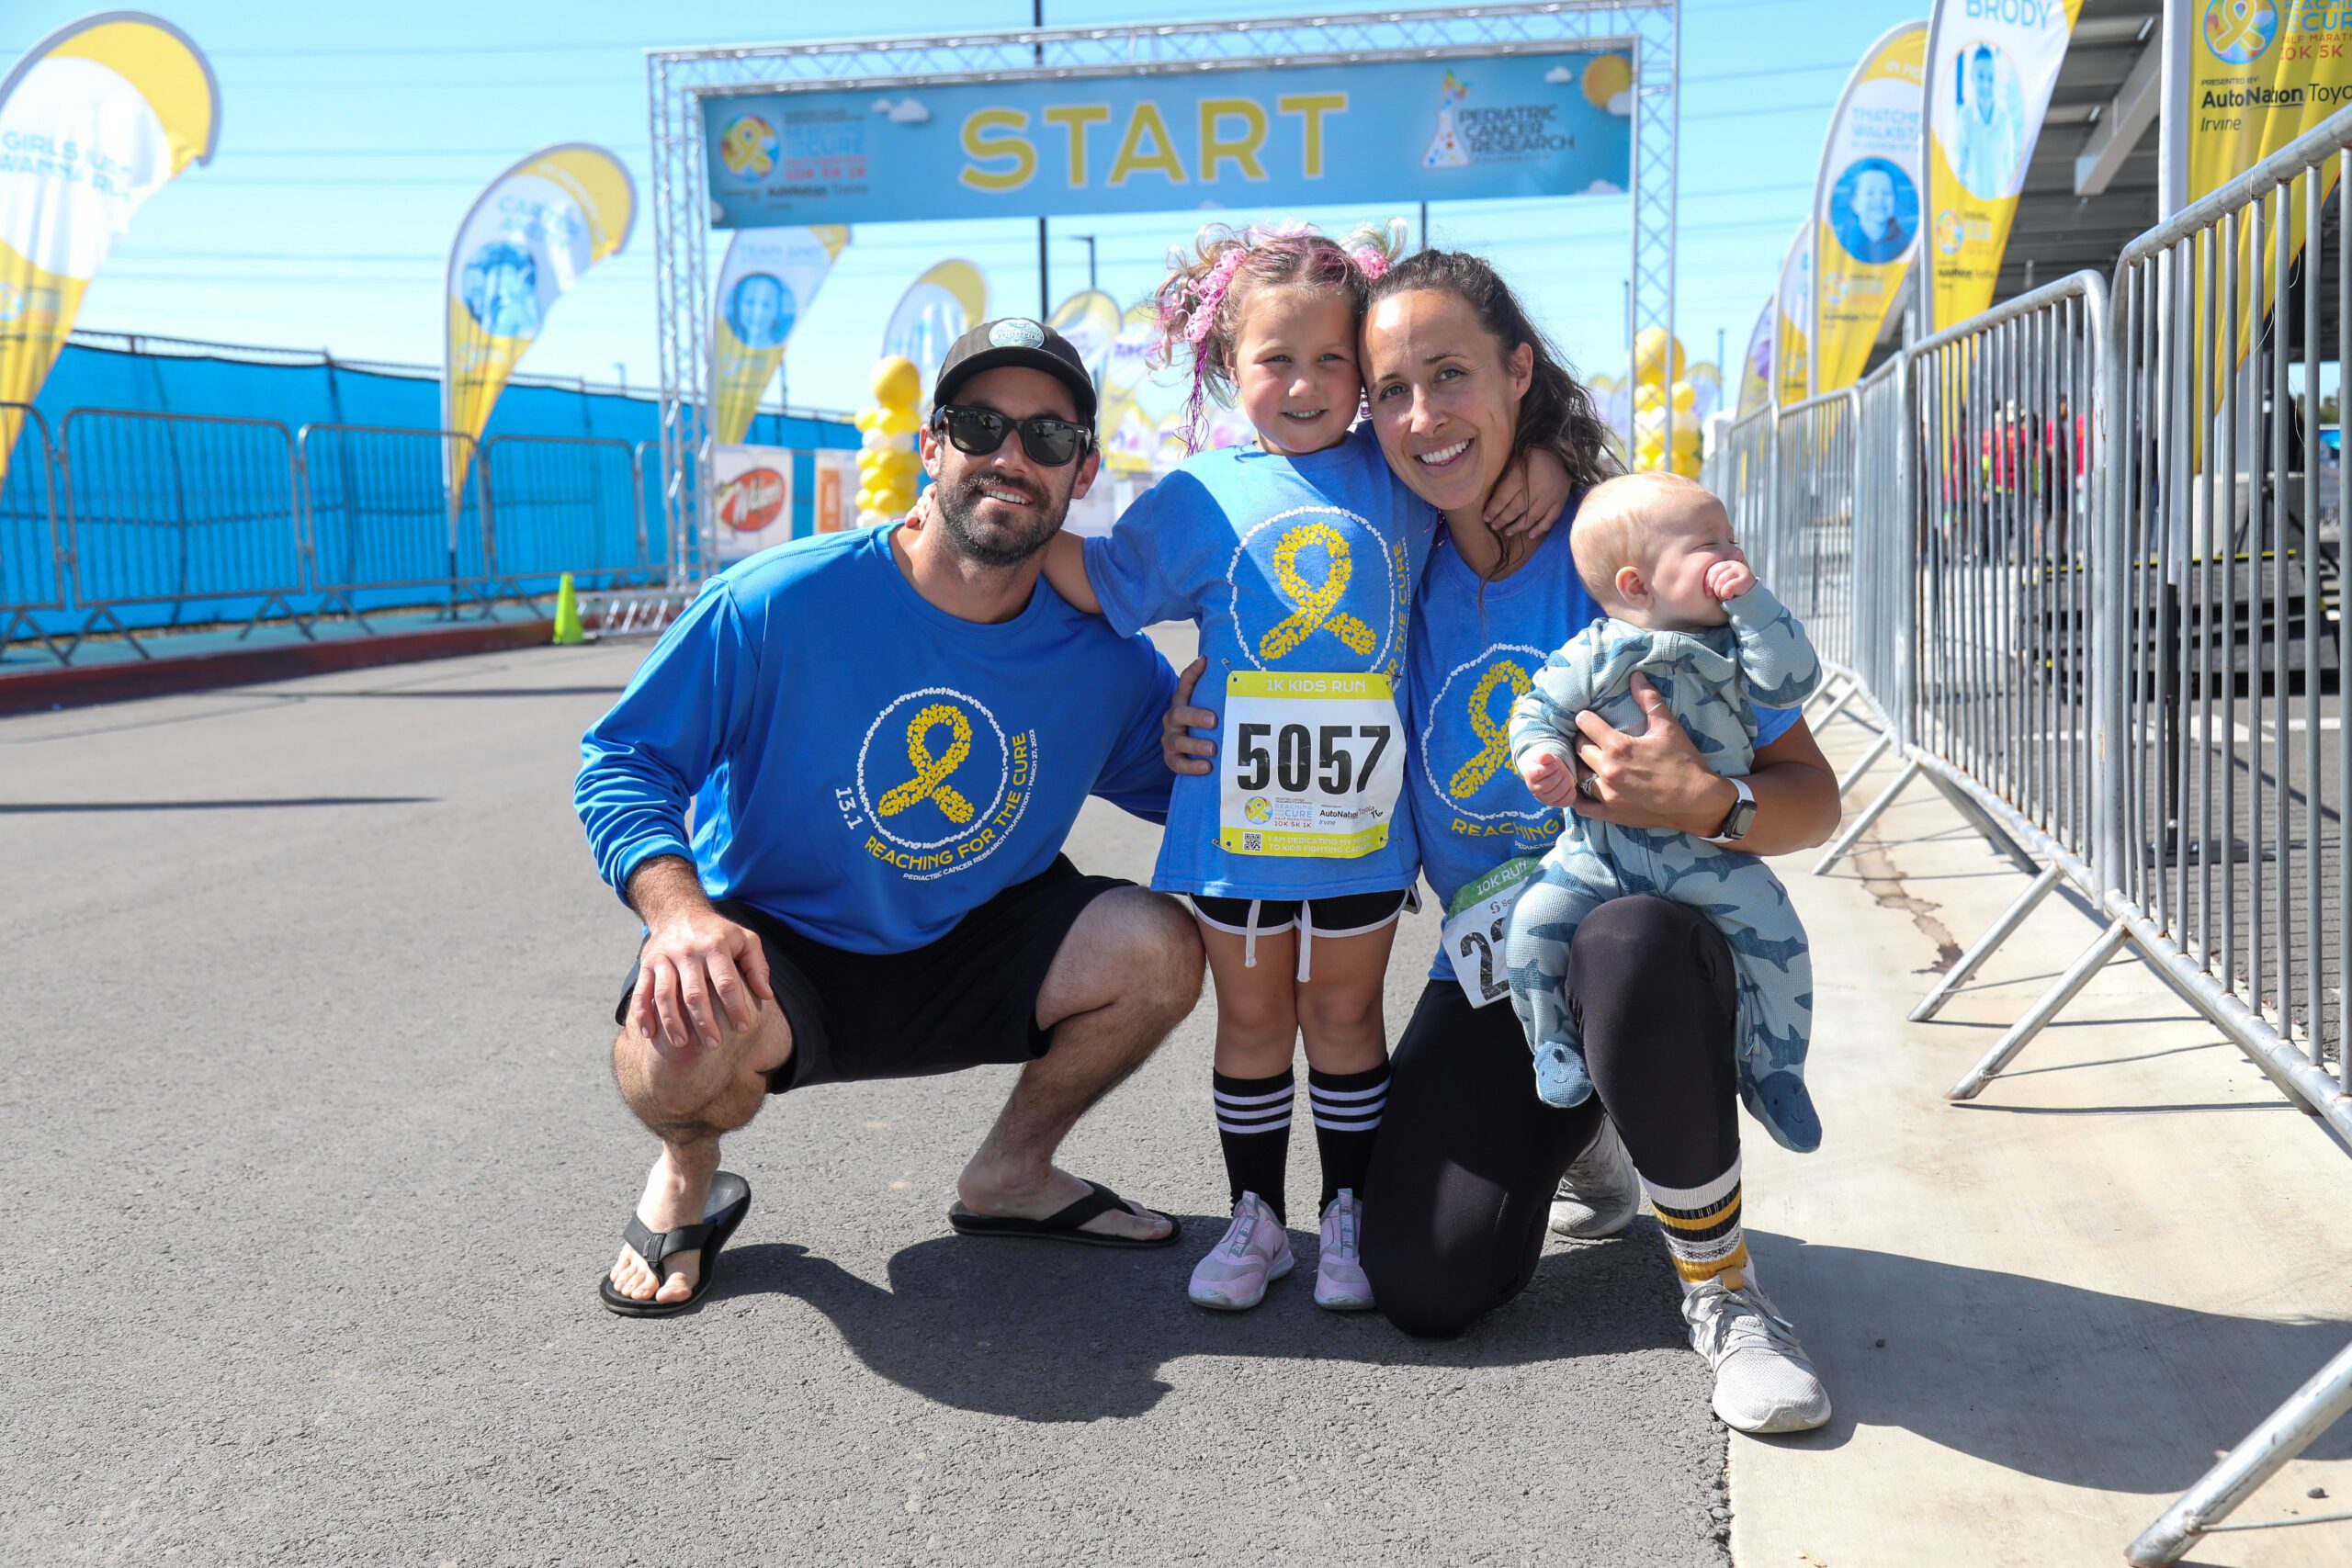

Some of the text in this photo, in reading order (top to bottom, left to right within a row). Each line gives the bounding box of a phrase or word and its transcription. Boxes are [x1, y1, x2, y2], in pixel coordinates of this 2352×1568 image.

[1966, 0, 2052, 30] BRODY
[2309, 33, 2352, 42] MARAT
[2319, 44, 2343, 59] 5K
[1458, 104, 1558, 122] PEDIATRIC
[2201, 117, 2242, 131] Irvine
[1464, 118, 1544, 140] CANCER
[2, 130, 79, 161] GIRLS
[960, 93, 1349, 192] START
[1471, 134, 1575, 152] RESEARCH
[1393, 539, 1408, 605] CURE
[1266, 680, 1366, 693] 1K KIDS RUN
[1028, 728, 1037, 747] 2022
[1237, 723, 1391, 795] 5057
[1028, 760, 1038, 786] MARCH
[835, 786, 864, 830] 13.1
[865, 732, 1027, 871] REACHING FOR THE CURE
[1004, 791, 1031, 836] FOUNDATION
[1284, 809, 1313, 818] CURE
[1451, 818, 1559, 840] REACHING
[974, 834, 1007, 863] RESEARCH
[1304, 845, 1343, 853] FIGHTING
[943, 860, 973, 874] CANCER
[1477, 860, 1528, 896] 10K RUN
